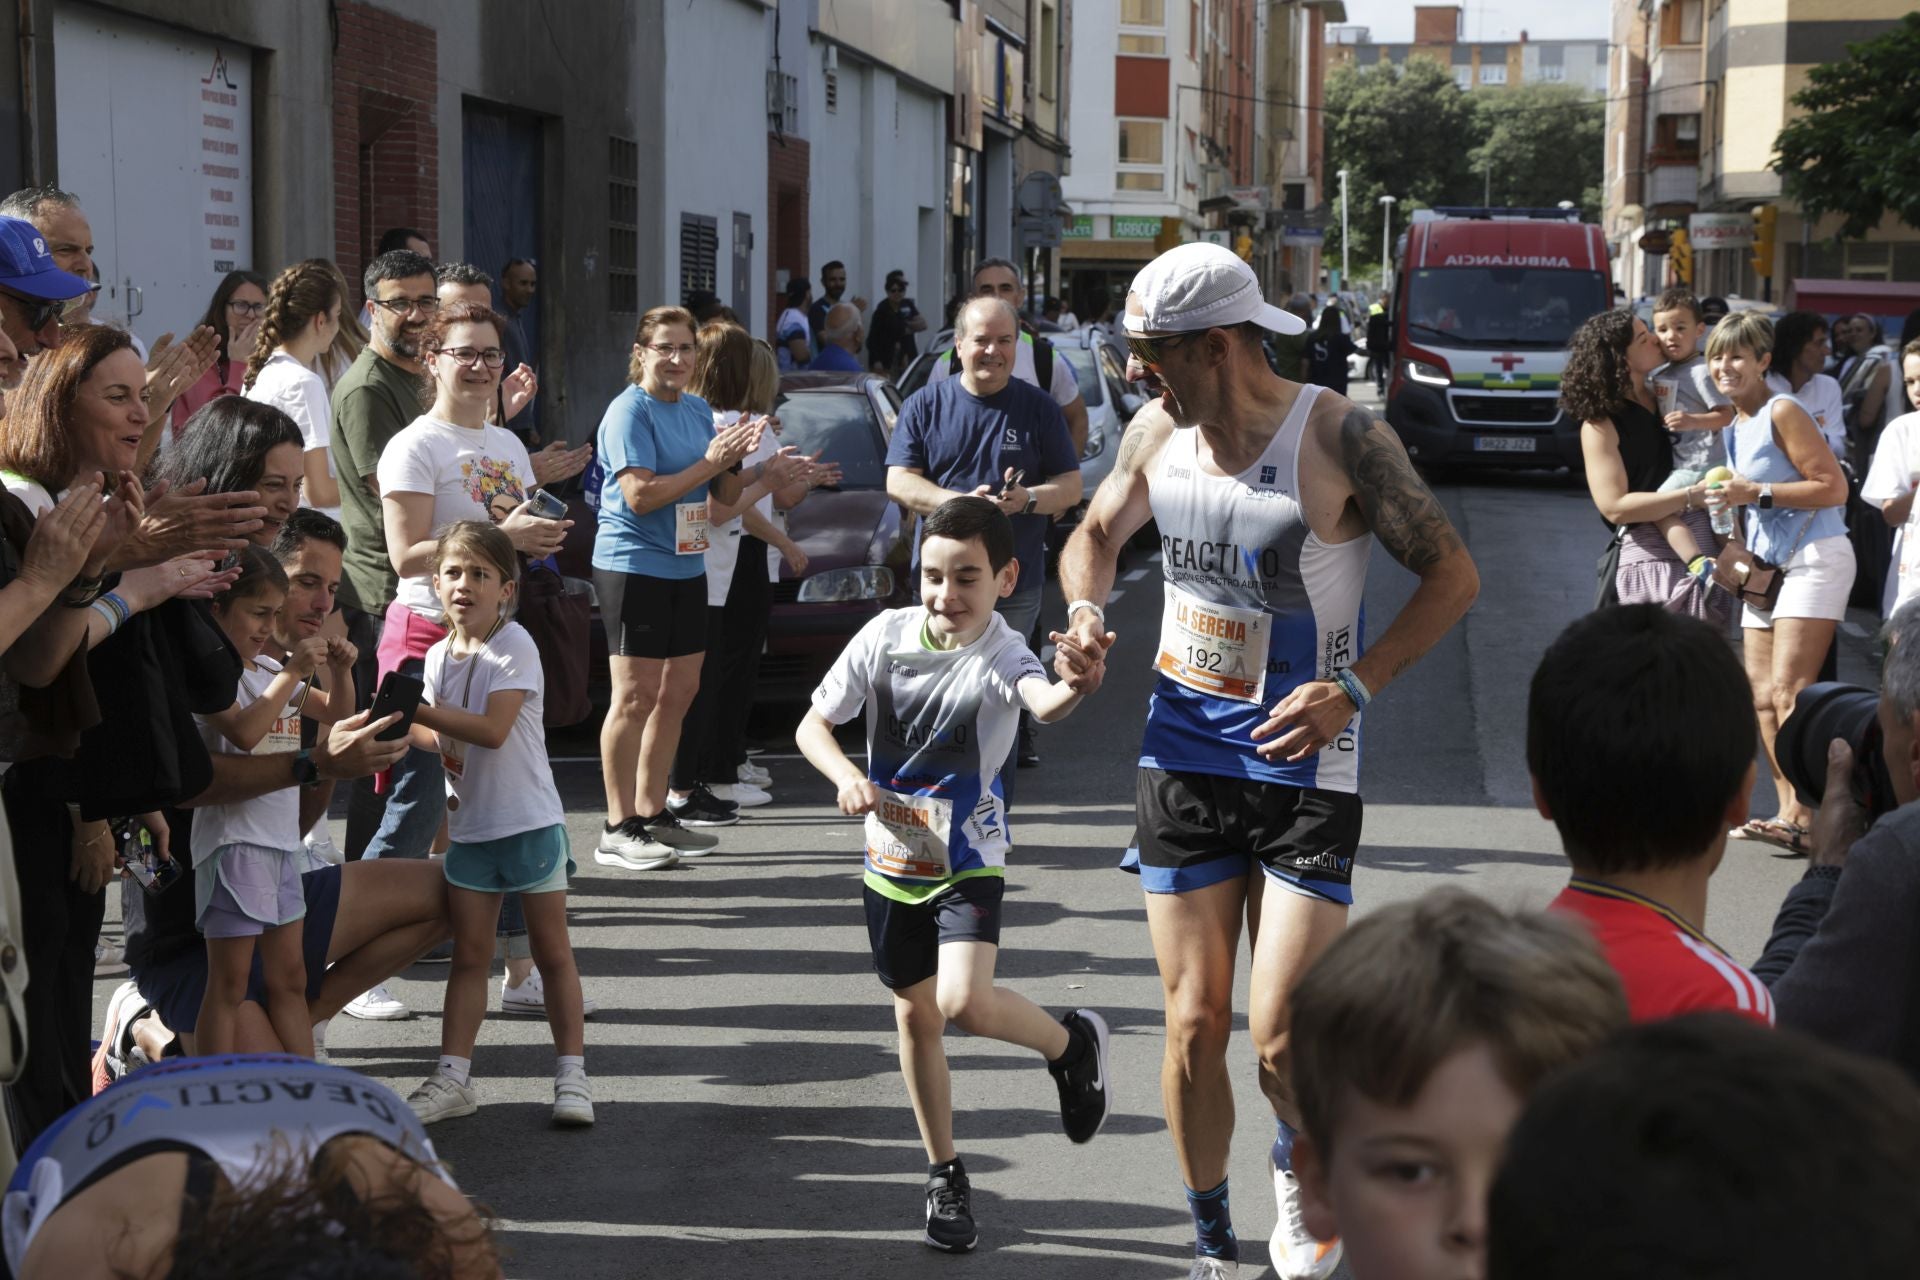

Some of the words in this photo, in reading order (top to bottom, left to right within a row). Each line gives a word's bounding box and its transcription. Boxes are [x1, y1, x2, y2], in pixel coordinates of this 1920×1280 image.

[1006, 428, 1018, 443] S
[1245, 486, 1284, 499] OVIEDO
[1162, 535, 1279, 578] CEACTIVO
[1196, 574, 1239, 588] ESPECTRO
[1176, 601, 1188, 625] LA
[1191, 609, 1247, 643] SERENA
[1186, 645, 1222, 673] 192
[883, 801, 929, 829] SERENA
[86, 1081, 395, 1150] CEACTIVO
